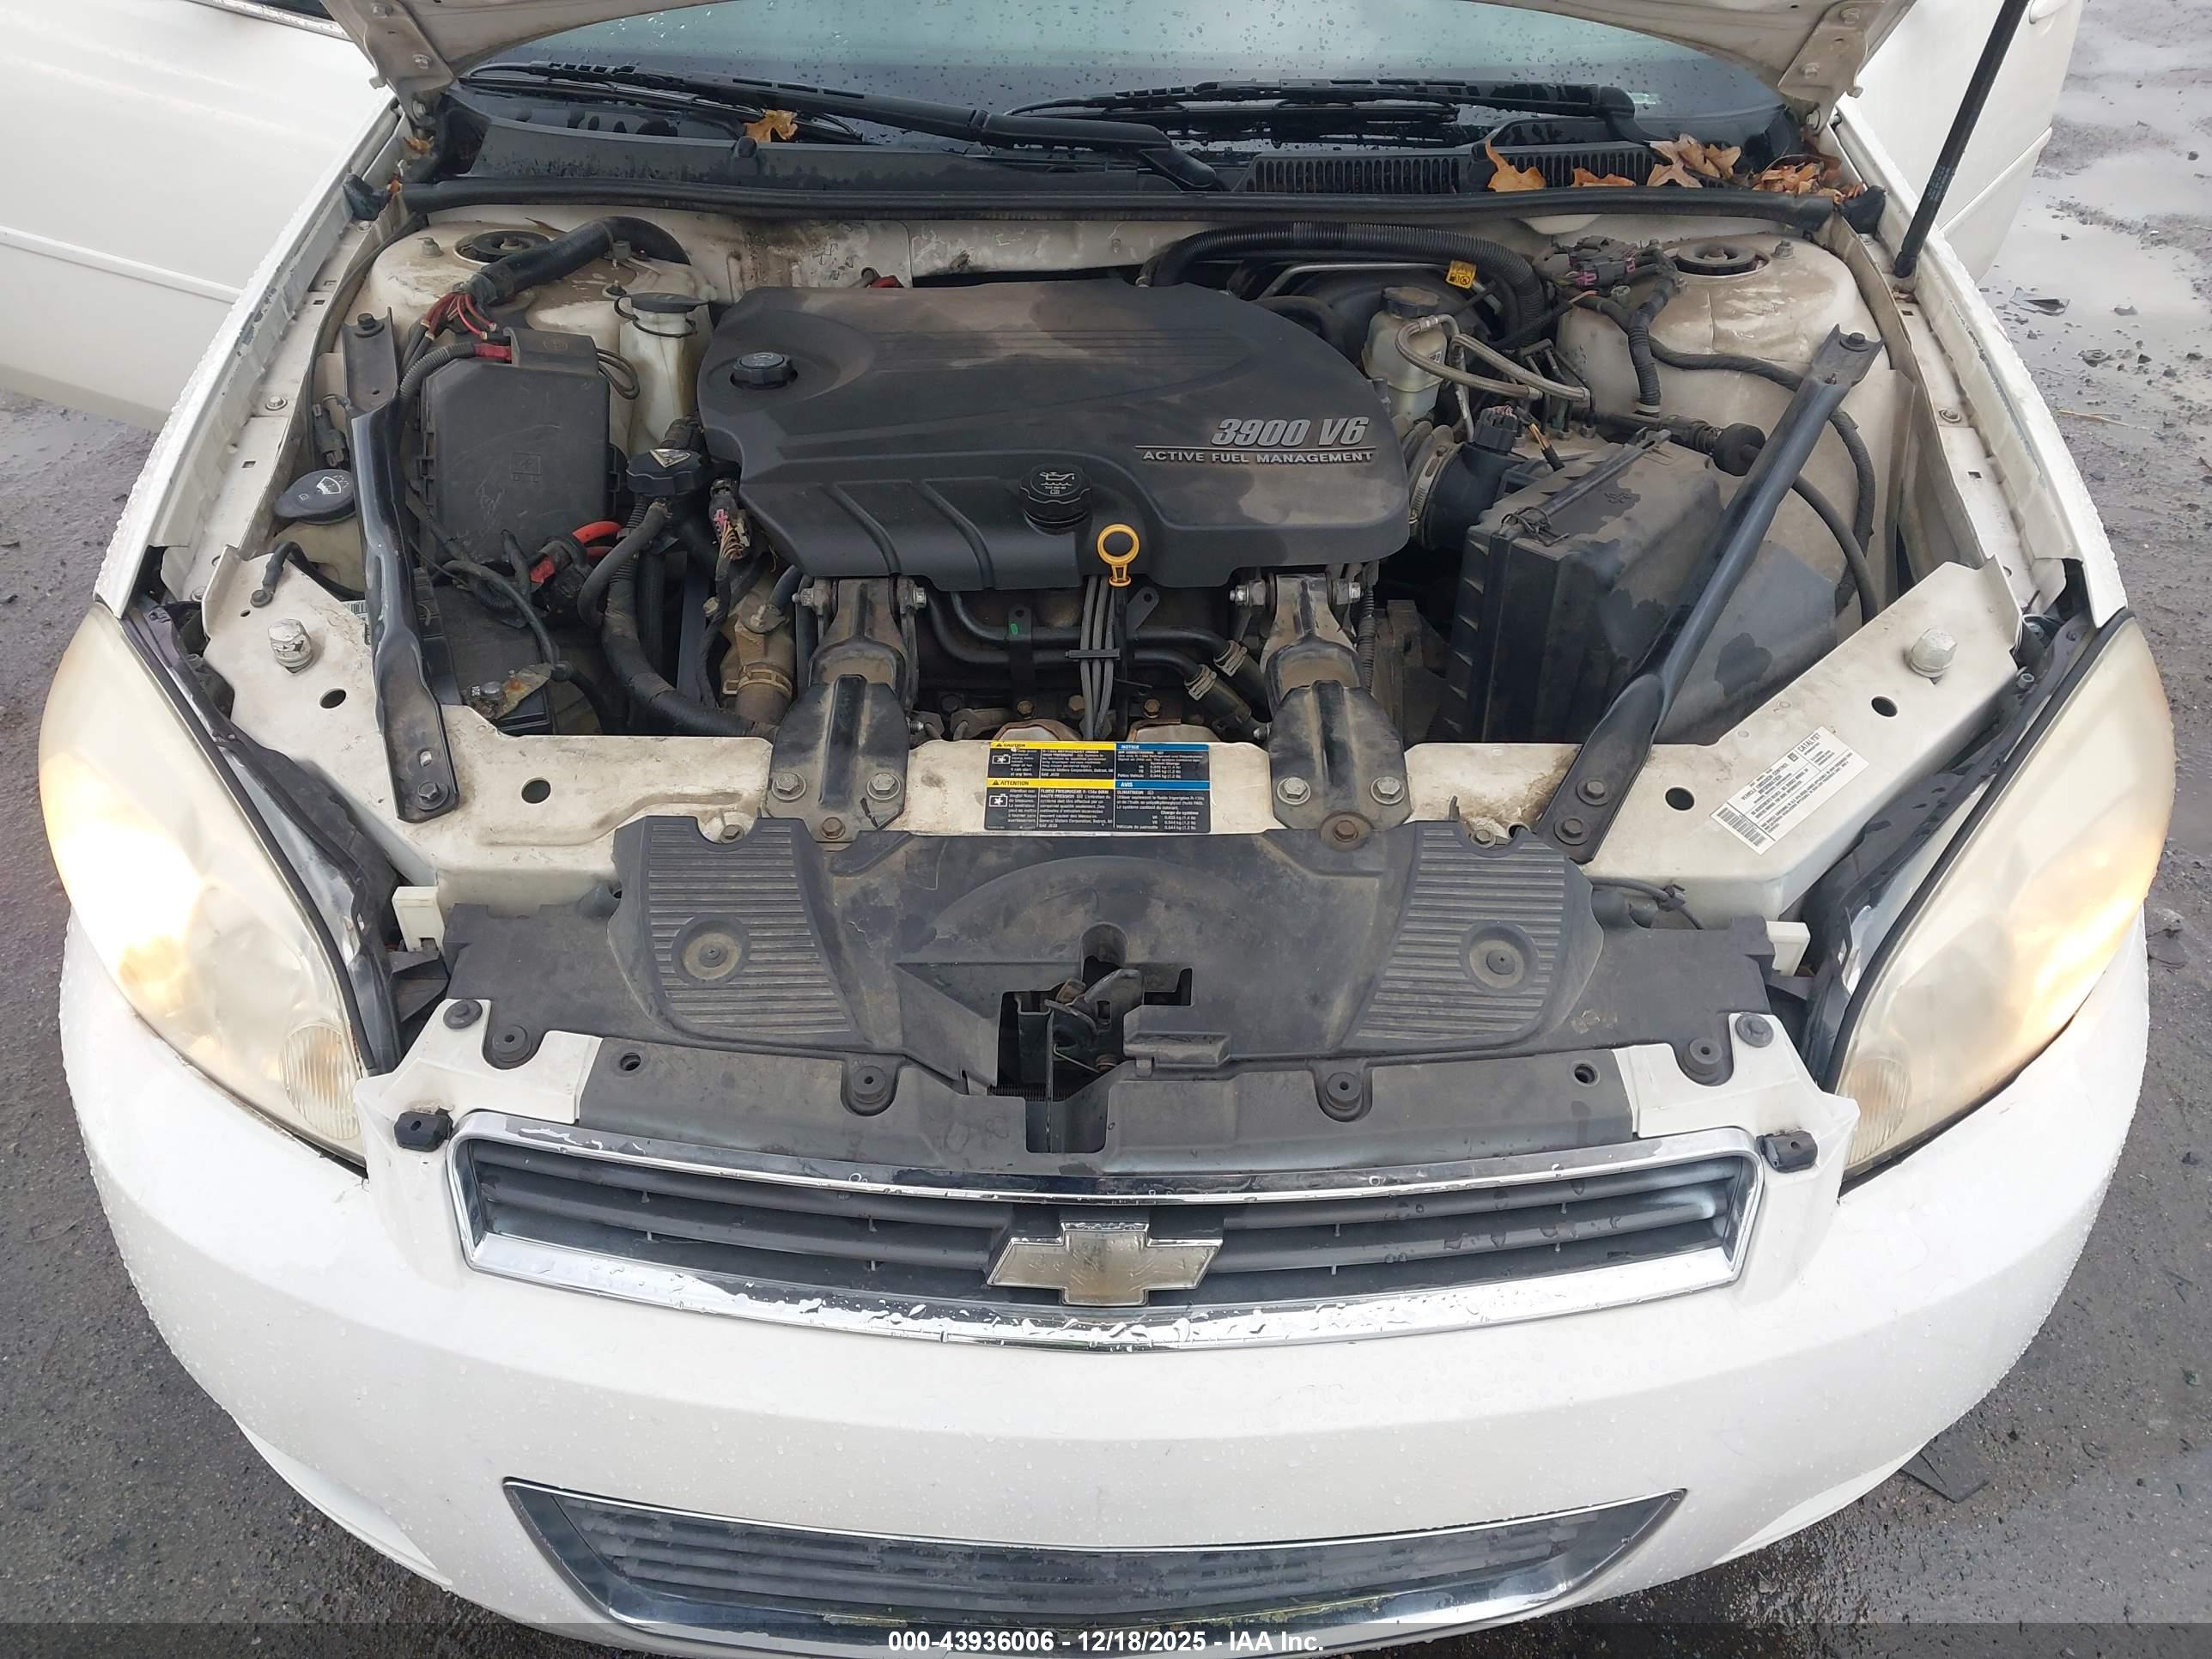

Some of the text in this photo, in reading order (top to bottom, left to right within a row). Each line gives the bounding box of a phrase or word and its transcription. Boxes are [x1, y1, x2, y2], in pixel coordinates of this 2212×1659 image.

[1211, 416, 1370, 447] 3900 V6
[1143, 451, 1372, 464] ACTIVE FUEL MANAGEMENT
[1797, 732, 1821, 752] CATALYST
